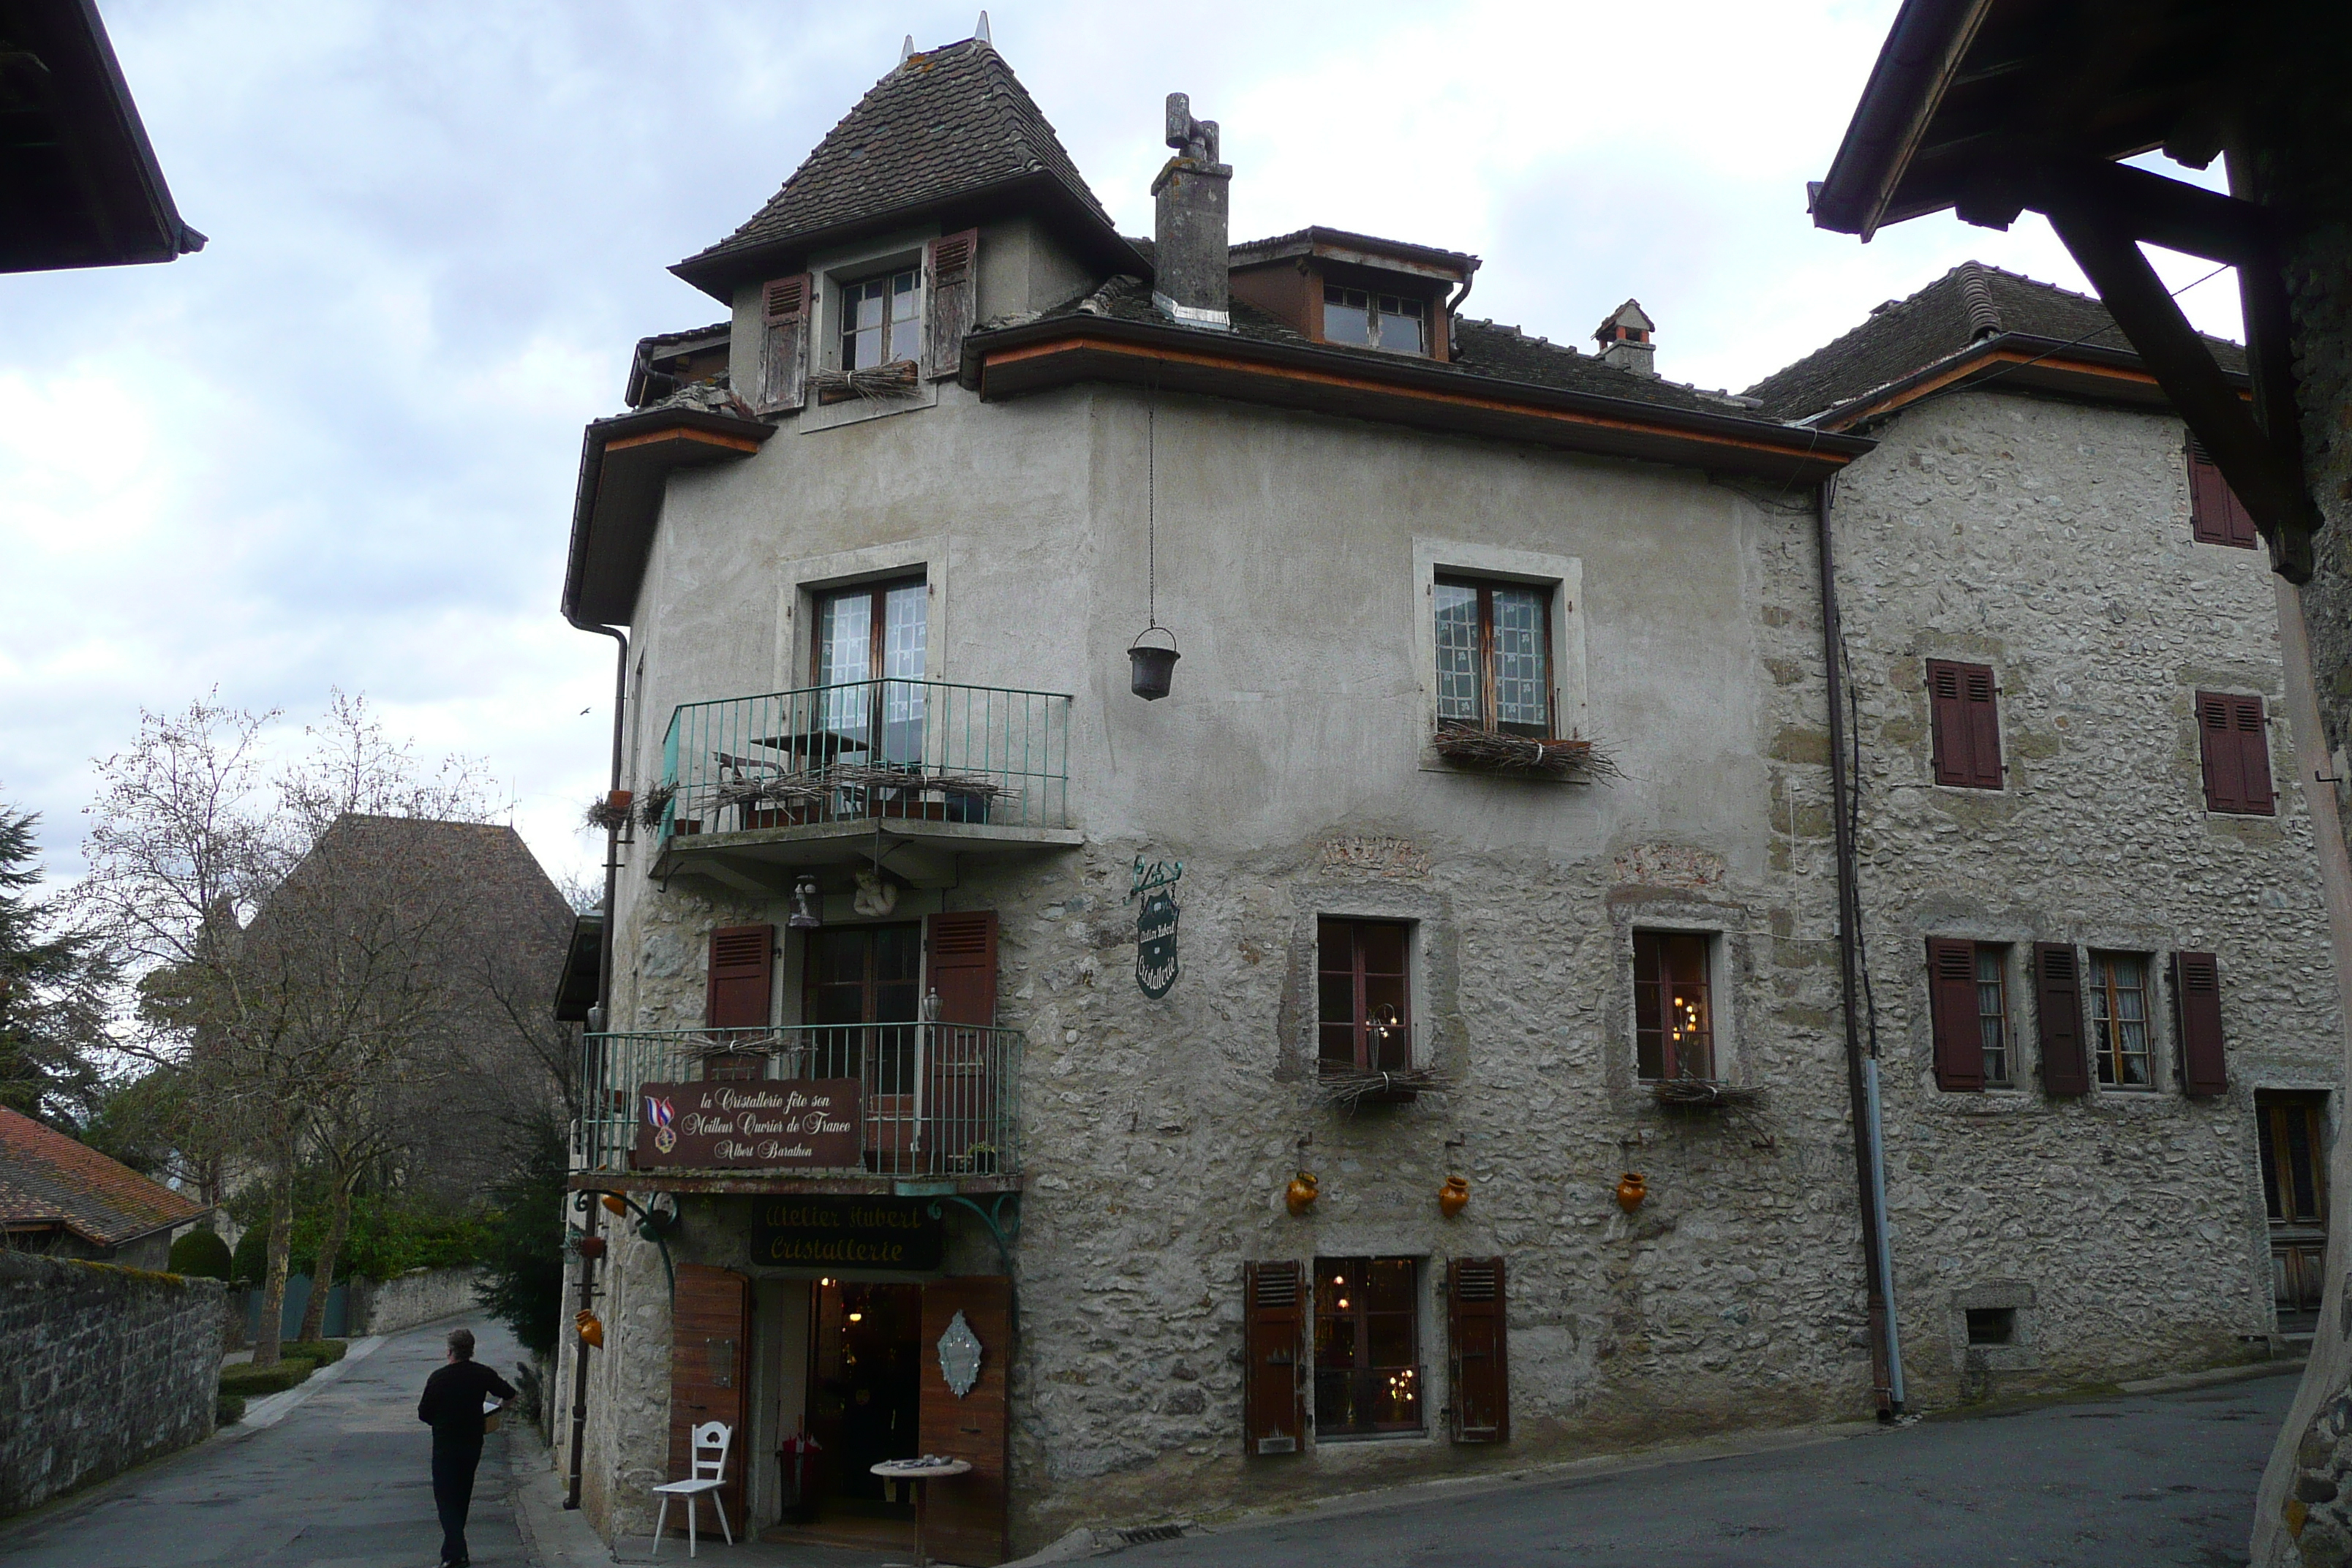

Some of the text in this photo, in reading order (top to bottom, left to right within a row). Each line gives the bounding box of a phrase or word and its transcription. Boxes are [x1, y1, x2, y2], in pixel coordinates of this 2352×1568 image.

[1139, 955, 1175, 990] Cristallerie
[700, 1087, 830, 1114] la Cristallerie fête son
[681, 1110, 851, 1136] Meilleur Ouvrier de France
[714, 1139, 813, 1160] Albert Barathon
[766, 1206, 921, 1229] Atelier Hubert
[771, 1235, 903, 1262] Cristallerie
